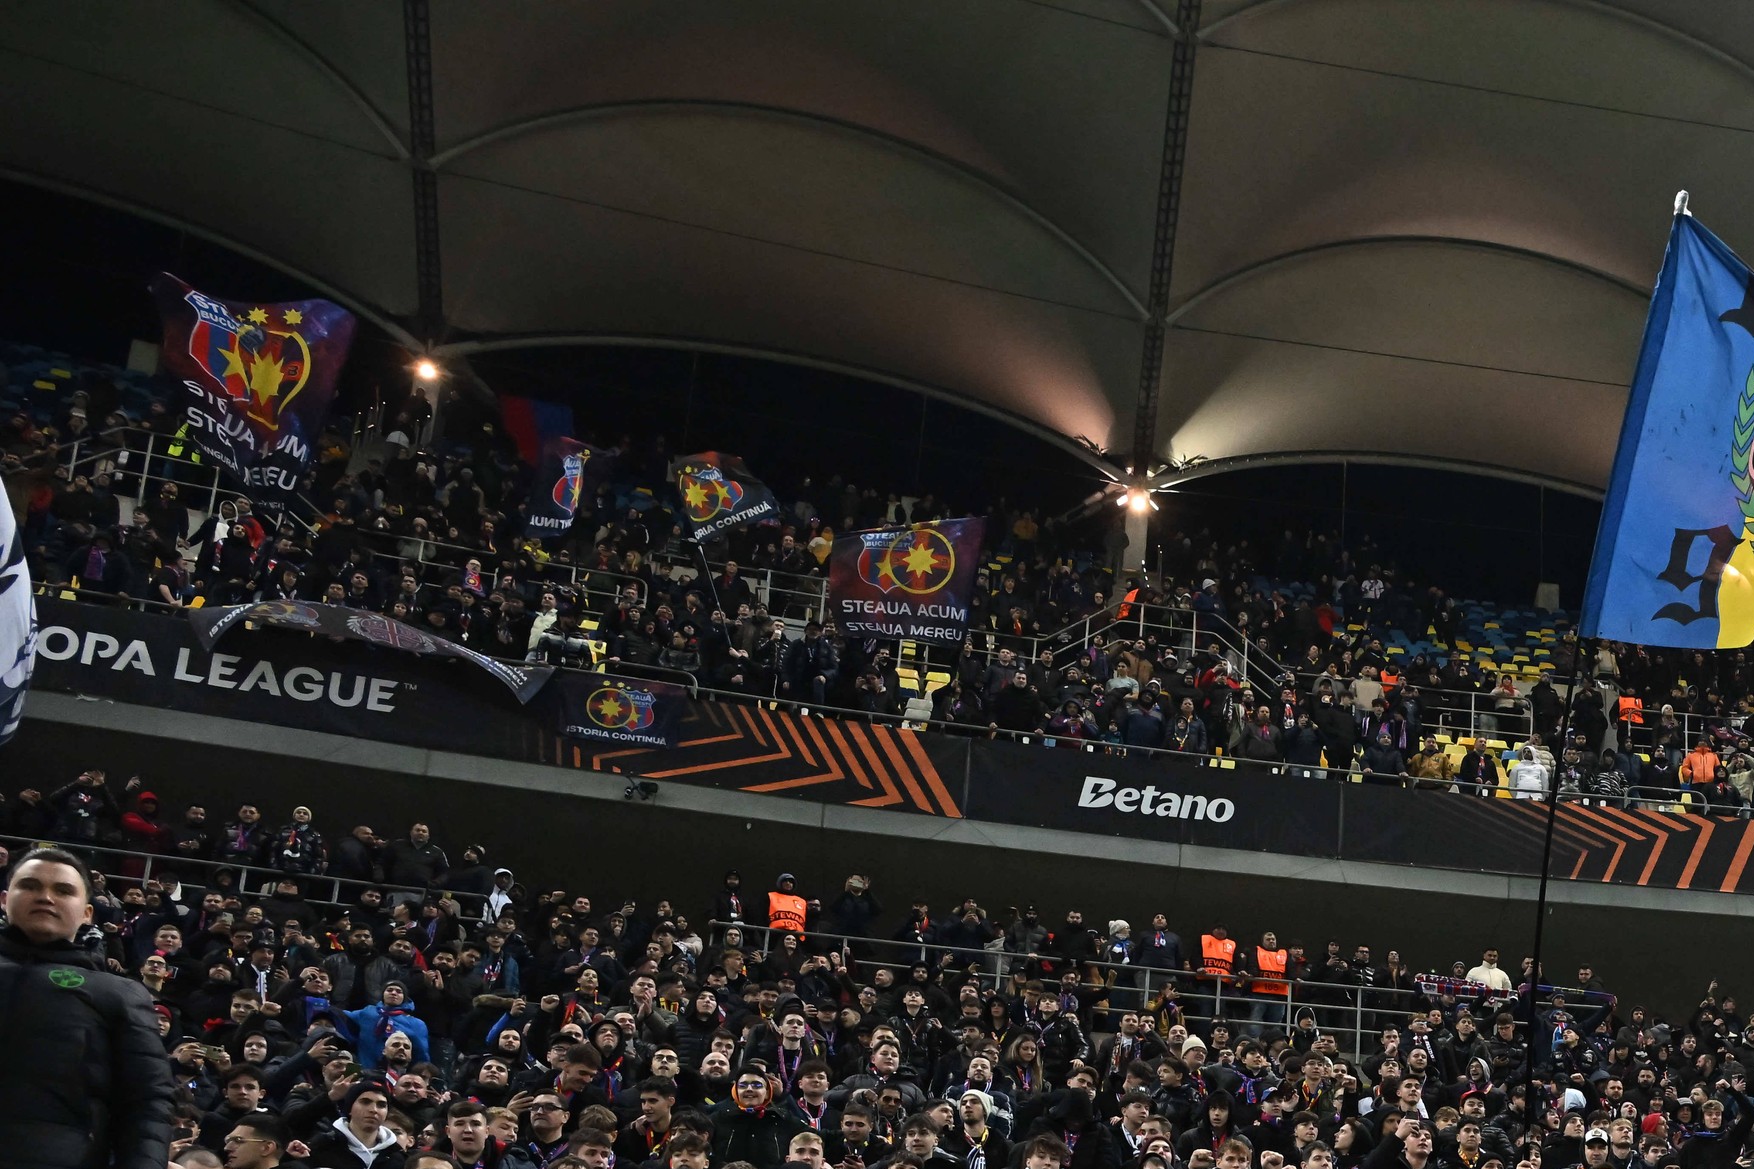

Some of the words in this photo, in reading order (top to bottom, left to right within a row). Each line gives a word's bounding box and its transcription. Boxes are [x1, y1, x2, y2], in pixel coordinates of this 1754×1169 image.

[842, 600, 912, 616] STEAUA
[917, 604, 965, 622] ACUM
[846, 622, 904, 636] STEAUA
[910, 624, 963, 641] MEREU
[174, 646, 400, 713] LEAGUE
[566, 725, 609, 738] ISTORIA
[1077, 775, 1236, 823] Betano
